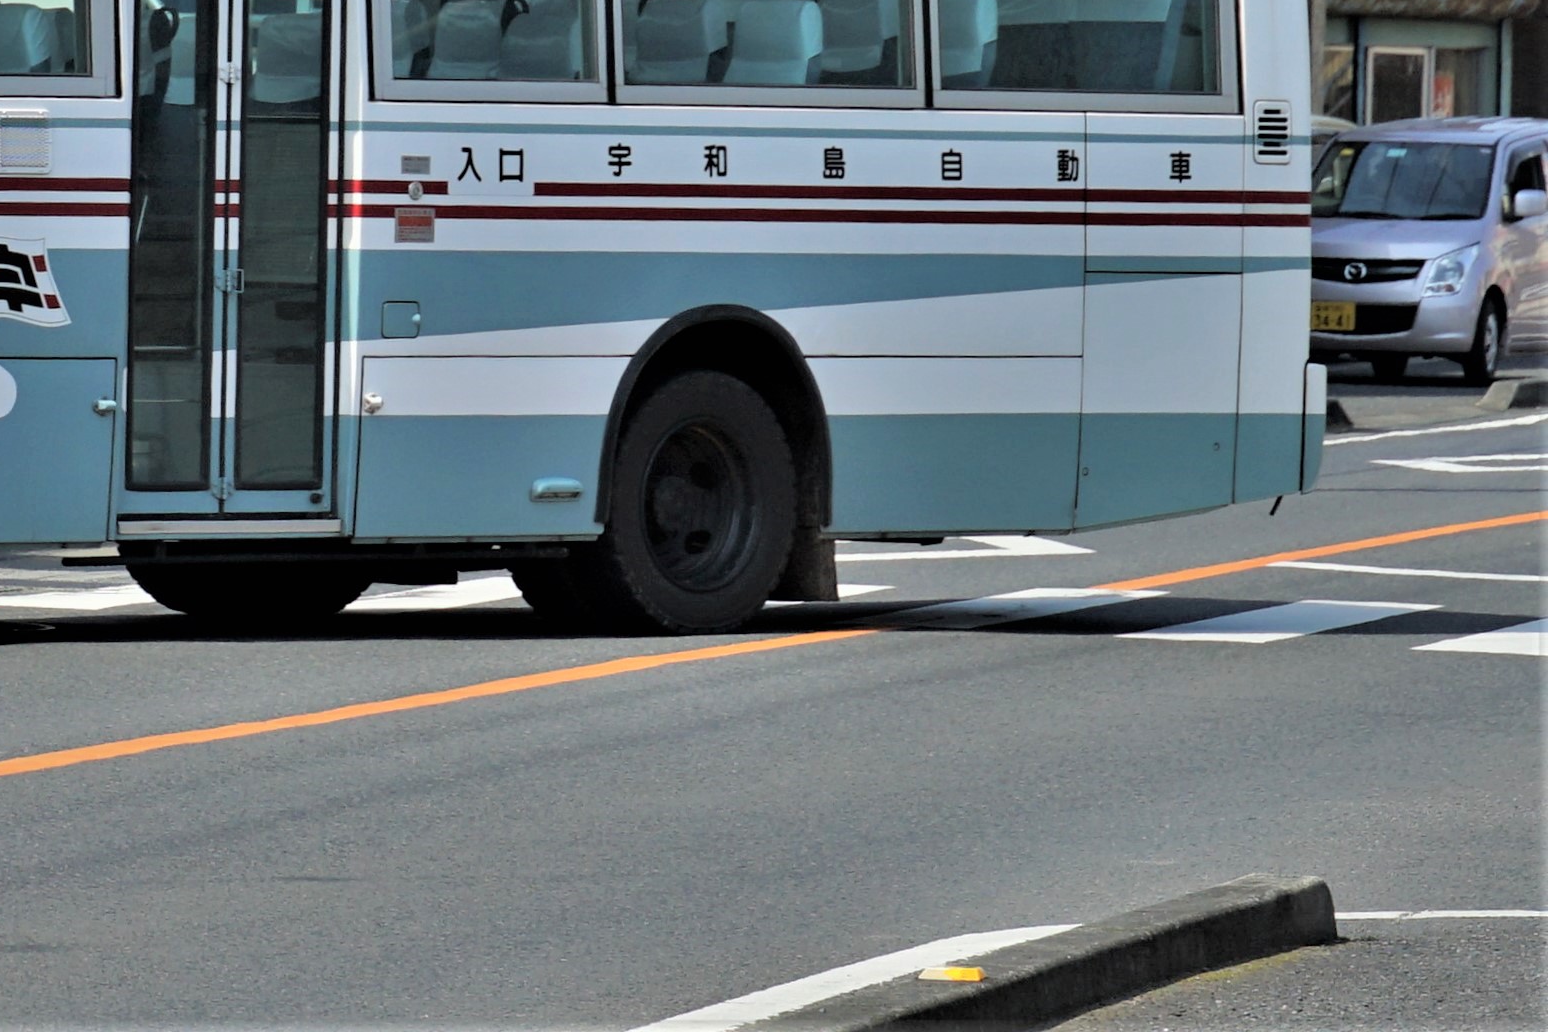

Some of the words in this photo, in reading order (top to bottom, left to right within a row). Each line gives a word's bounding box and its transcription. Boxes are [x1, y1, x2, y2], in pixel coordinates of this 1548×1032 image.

[457, 146, 525, 183] 入口
[607, 142, 1192, 184] 宇和島自動車
